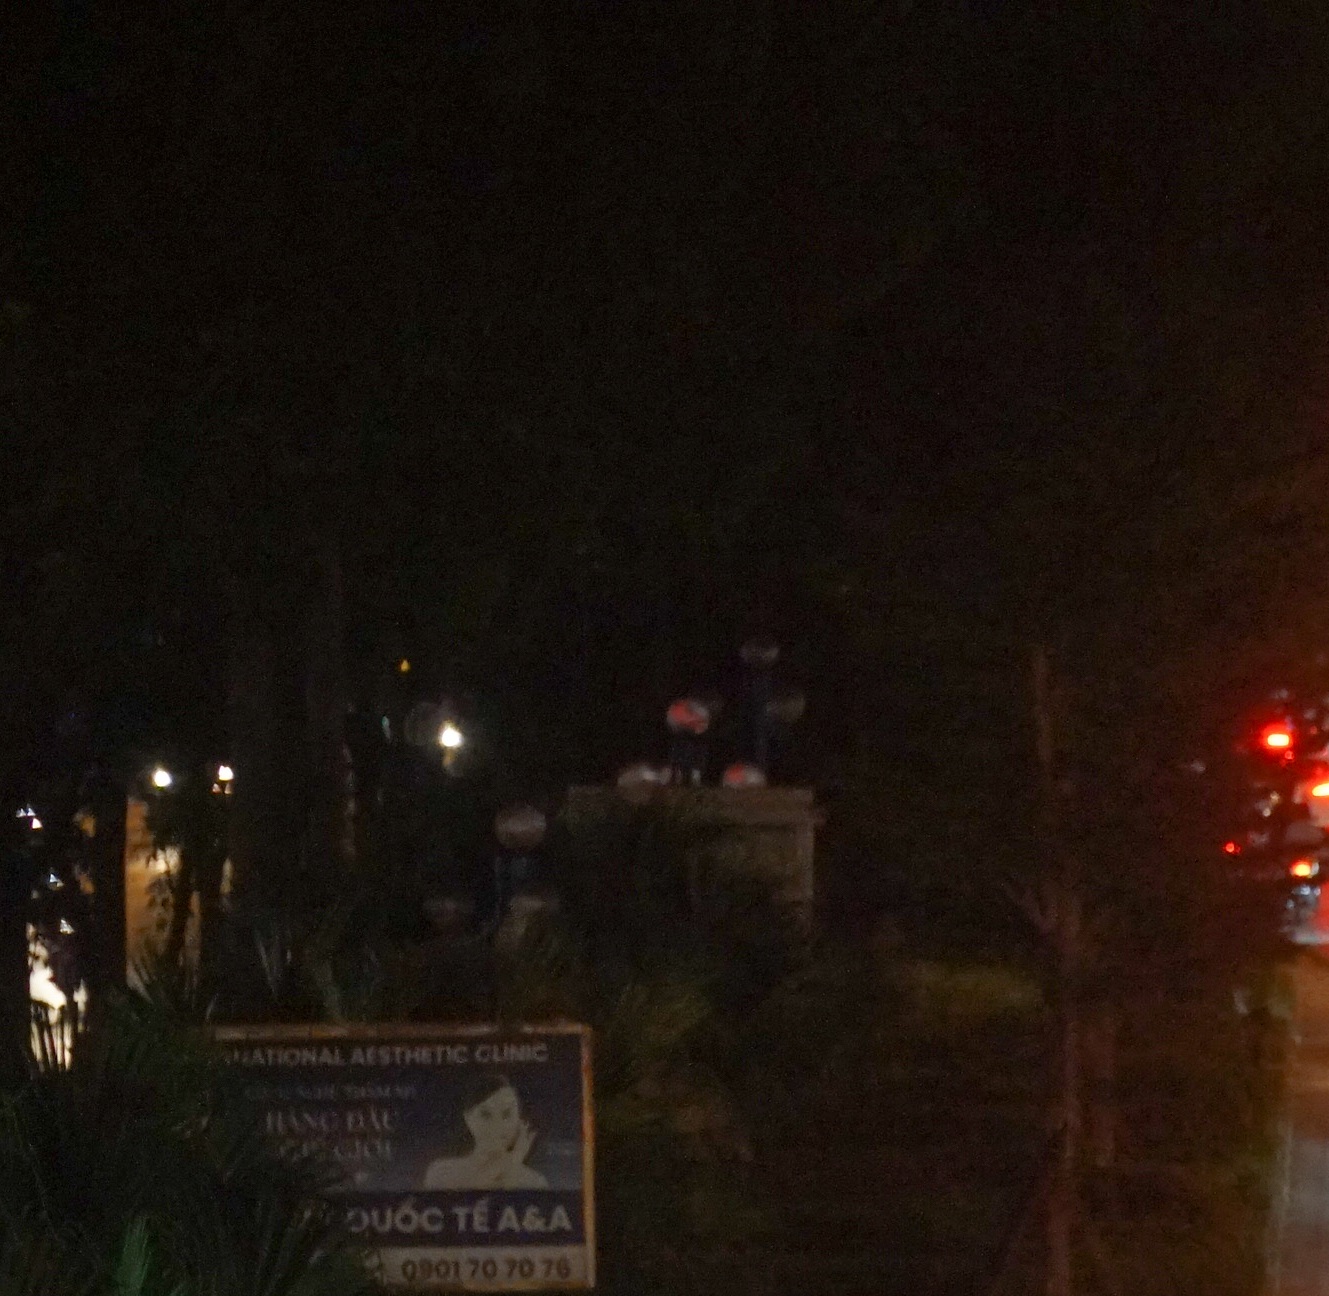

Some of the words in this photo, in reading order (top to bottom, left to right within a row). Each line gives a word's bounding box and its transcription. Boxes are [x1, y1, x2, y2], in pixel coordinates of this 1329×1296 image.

[351, 1045, 470, 1066] AESTHETIC
[475, 1043, 550, 1063] CLINIC
[497, 1204, 574, 1233] A&A
[467, 1257, 498, 1280] 70
[508, 1257, 536, 1280] 70
